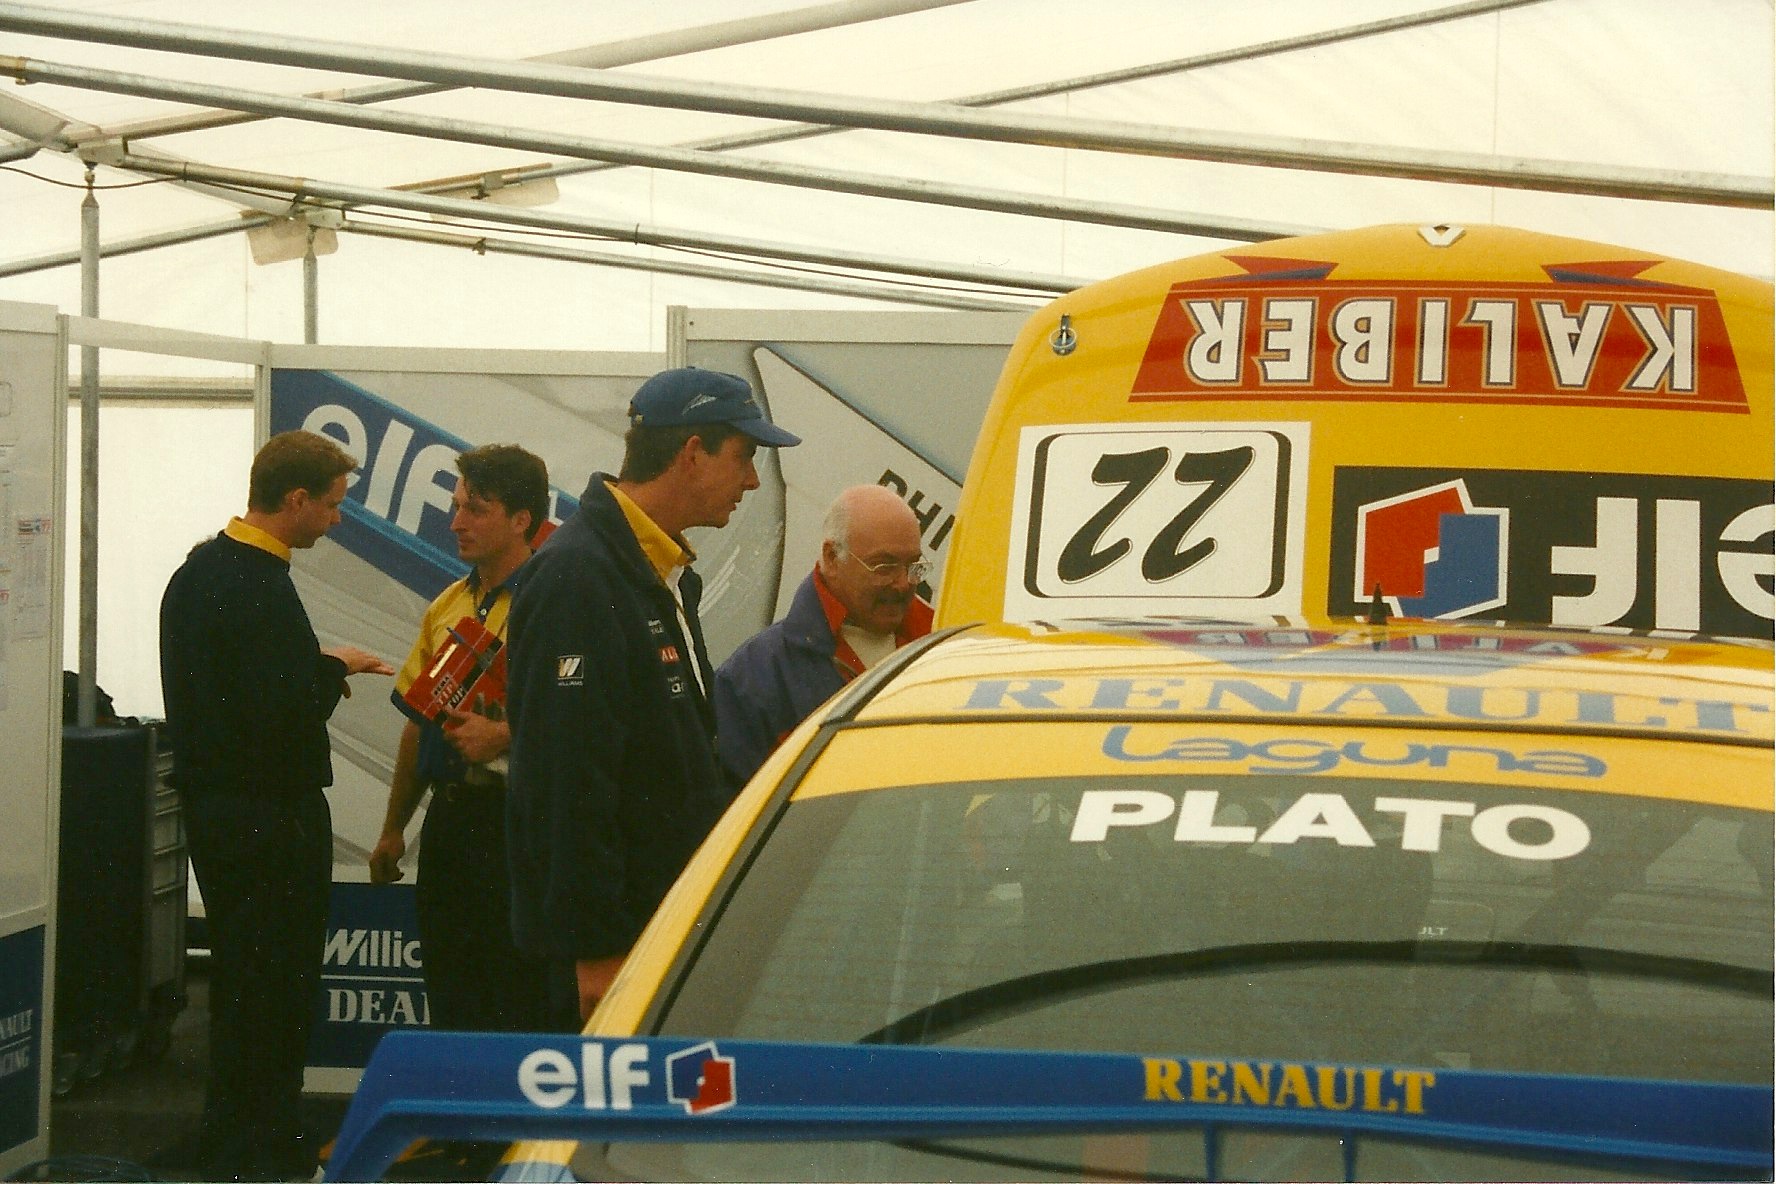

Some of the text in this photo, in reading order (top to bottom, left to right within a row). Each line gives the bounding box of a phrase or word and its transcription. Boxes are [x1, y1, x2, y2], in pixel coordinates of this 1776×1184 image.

[1181, 297, 1699, 393] KALIBER
[301, 404, 464, 535] elf
[877, 469, 956, 551] PHI
[1057, 446, 1256, 584] 22
[952, 678, 1772, 734] RENAULT
[1070, 790, 1591, 860] PLATO
[518, 1042, 649, 1110] elf
[1142, 1057, 1436, 1114] RENAULT
